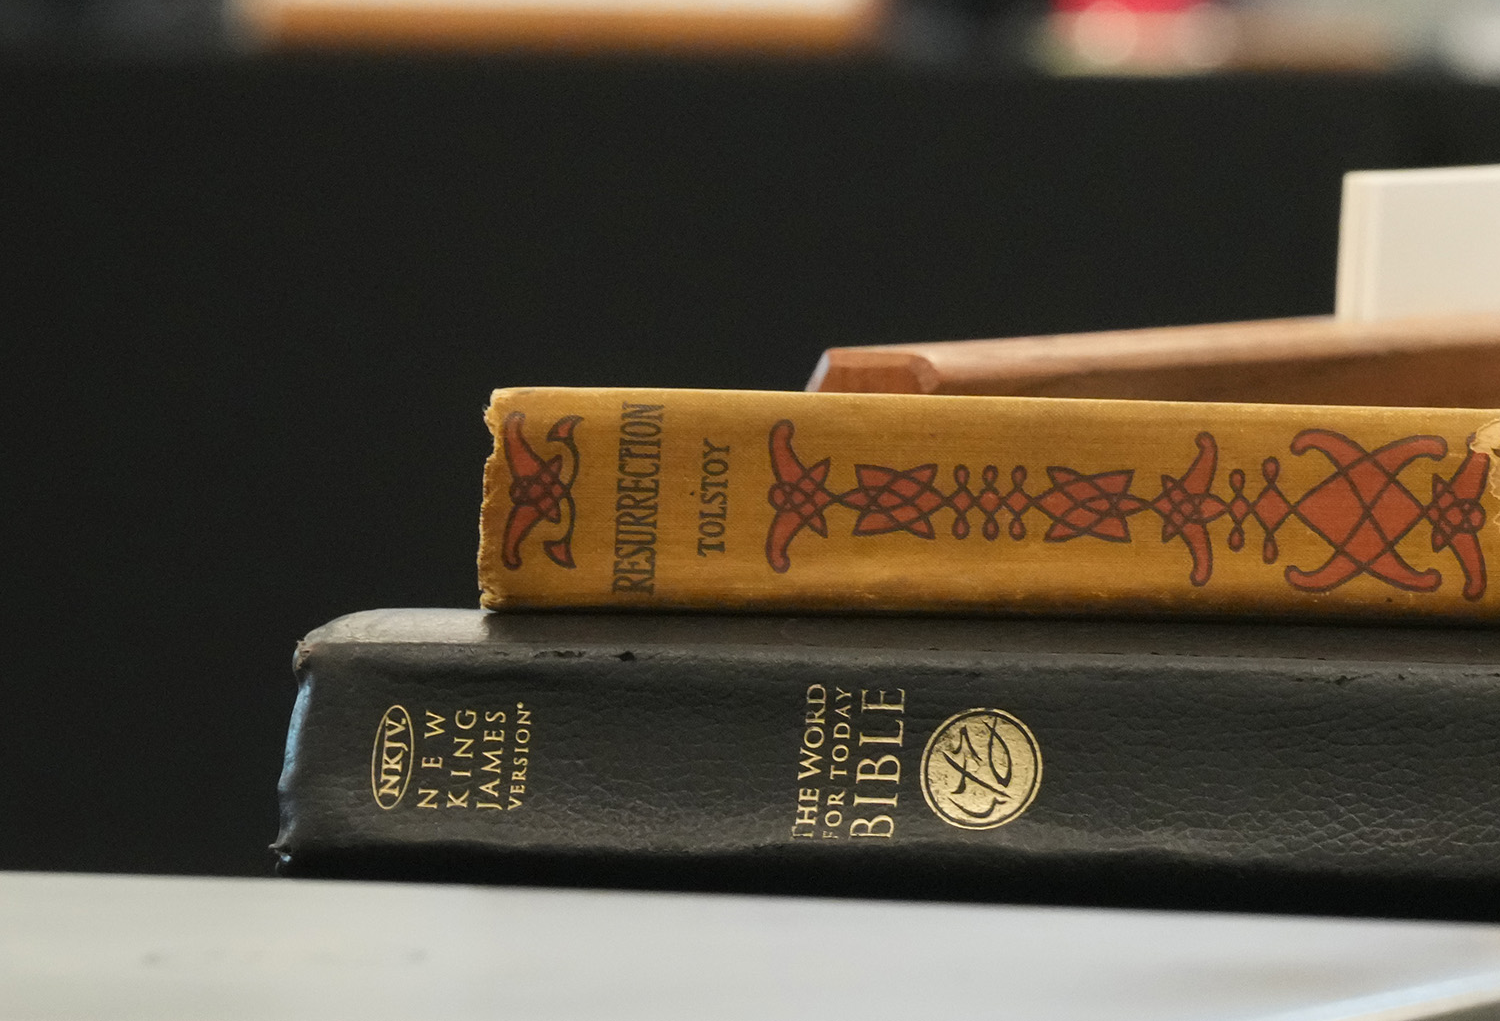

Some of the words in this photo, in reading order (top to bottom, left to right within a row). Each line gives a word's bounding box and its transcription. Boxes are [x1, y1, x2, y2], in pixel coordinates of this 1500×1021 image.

[611, 401, 665, 596] RESURRECTION
[697, 437, 730, 558] TOLSTOY
[416, 710, 446, 809] NEW
[446, 709, 477, 808] KING
[476, 711, 507, 810] JAMES
[797, 683, 827, 781] WORD
[830, 687, 853, 780] TODAY
[850, 688, 906, 839] BIBLE
[791, 787, 820, 840] THE
[822, 790, 846, 840] FOR
